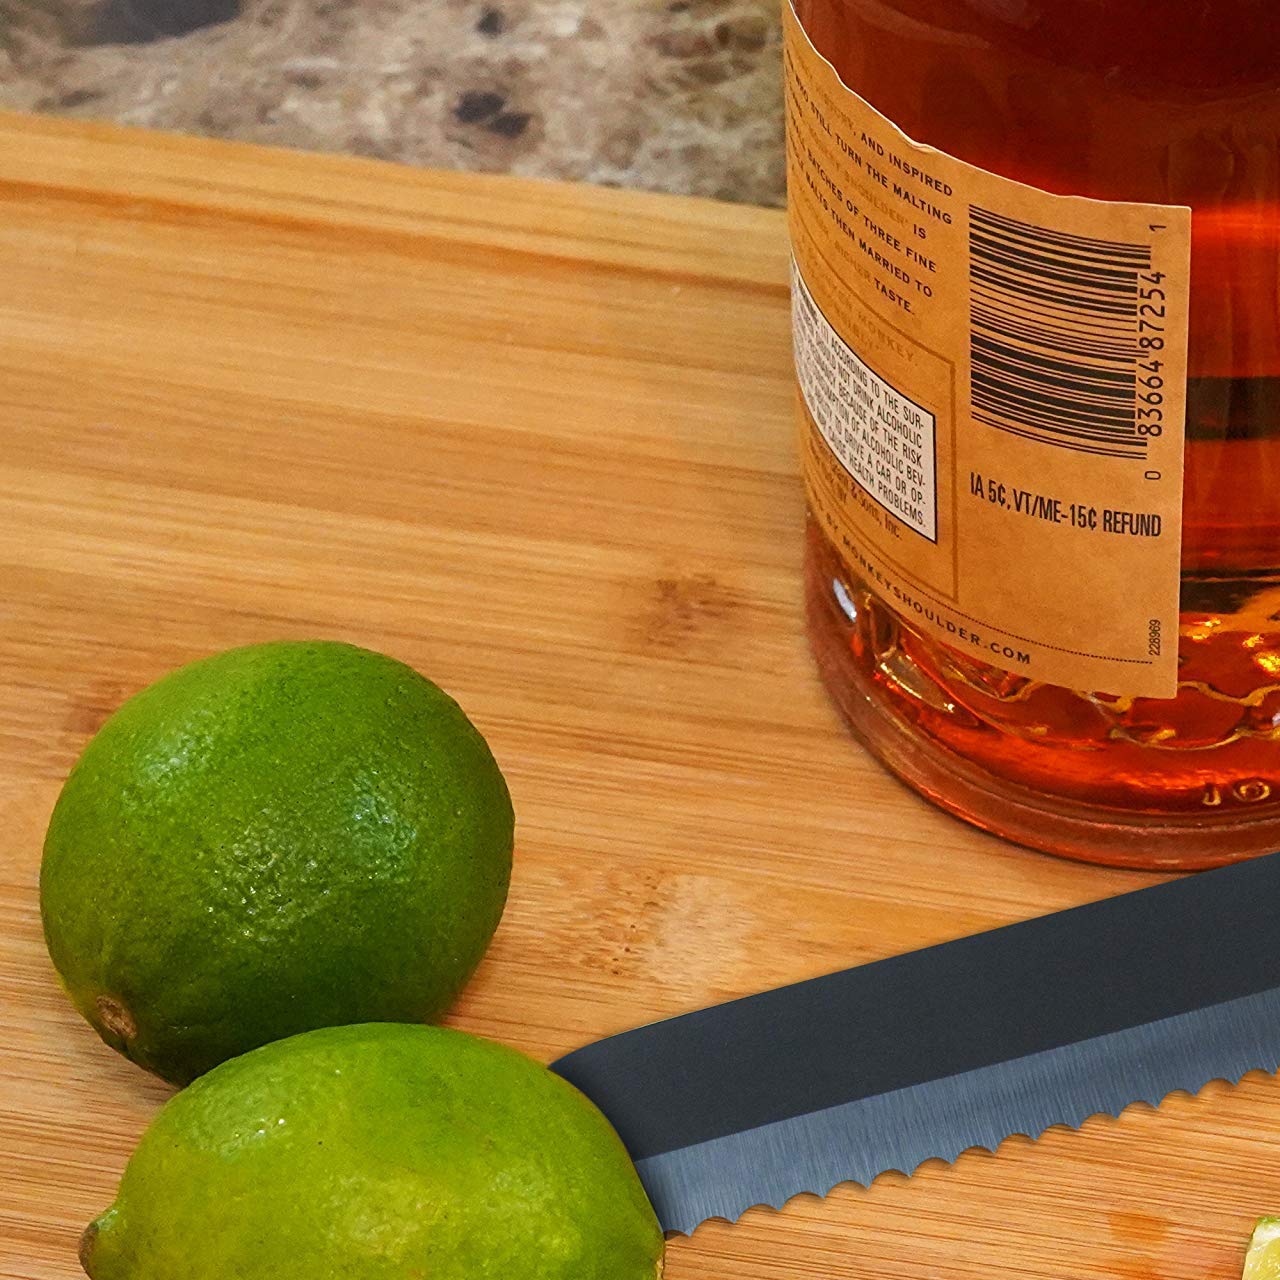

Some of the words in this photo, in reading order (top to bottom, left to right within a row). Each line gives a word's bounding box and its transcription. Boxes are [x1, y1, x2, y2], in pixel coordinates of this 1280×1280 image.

[835, 132, 862, 167] TURN
[866, 162, 888, 188] THE
[893, 182, 952, 225] MALTING
[860, 132, 885, 156] AND
[888, 152, 953, 197] INSPIRED
[831, 207, 856, 241] THEN
[858, 238, 910, 285] MARRIED
[915, 280, 933, 298] TO
[846, 200, 859, 217] OF
[863, 214, 901, 252] THREE
[906, 247, 937, 273] FINE
[913, 223, 927, 240] IS
[1148, 224, 1168, 232] 1
[1138, 271, 1167, 350] 87254
[837, 360, 851, 387] NOT
[853, 378, 875, 414] DRINK
[877, 404, 923, 450] ALCOHOLIC
[838, 380, 868, 426] BECAUSE
[870, 415, 880, 435] OF
[883, 427, 899, 453] THE
[902, 441, 923, 470] RISK
[870, 377, 881, 399] TO
[883, 389, 900, 415] THE
[903, 405, 925, 430] SUR-
[1137, 360, 1165, 437] 83664
[844, 427, 865, 461] DRIVE
[867, 453, 873, 470] A
[875, 459, 892, 484] CAR
[896, 475, 908, 497] OR
[911, 487, 927, 506] OP-
[848, 450, 875, 488] HEALTH
[852, 416, 861, 435] OF
[862, 428, 904, 475] ALCOHOLIC
[906, 464, 927, 488] BEV-
[1143, 470, 1162, 481] 0
[969, 471, 985, 500] IA
[1102, 509, 1162, 537] REFUND
[1148, 618, 1162, 657] 228969
